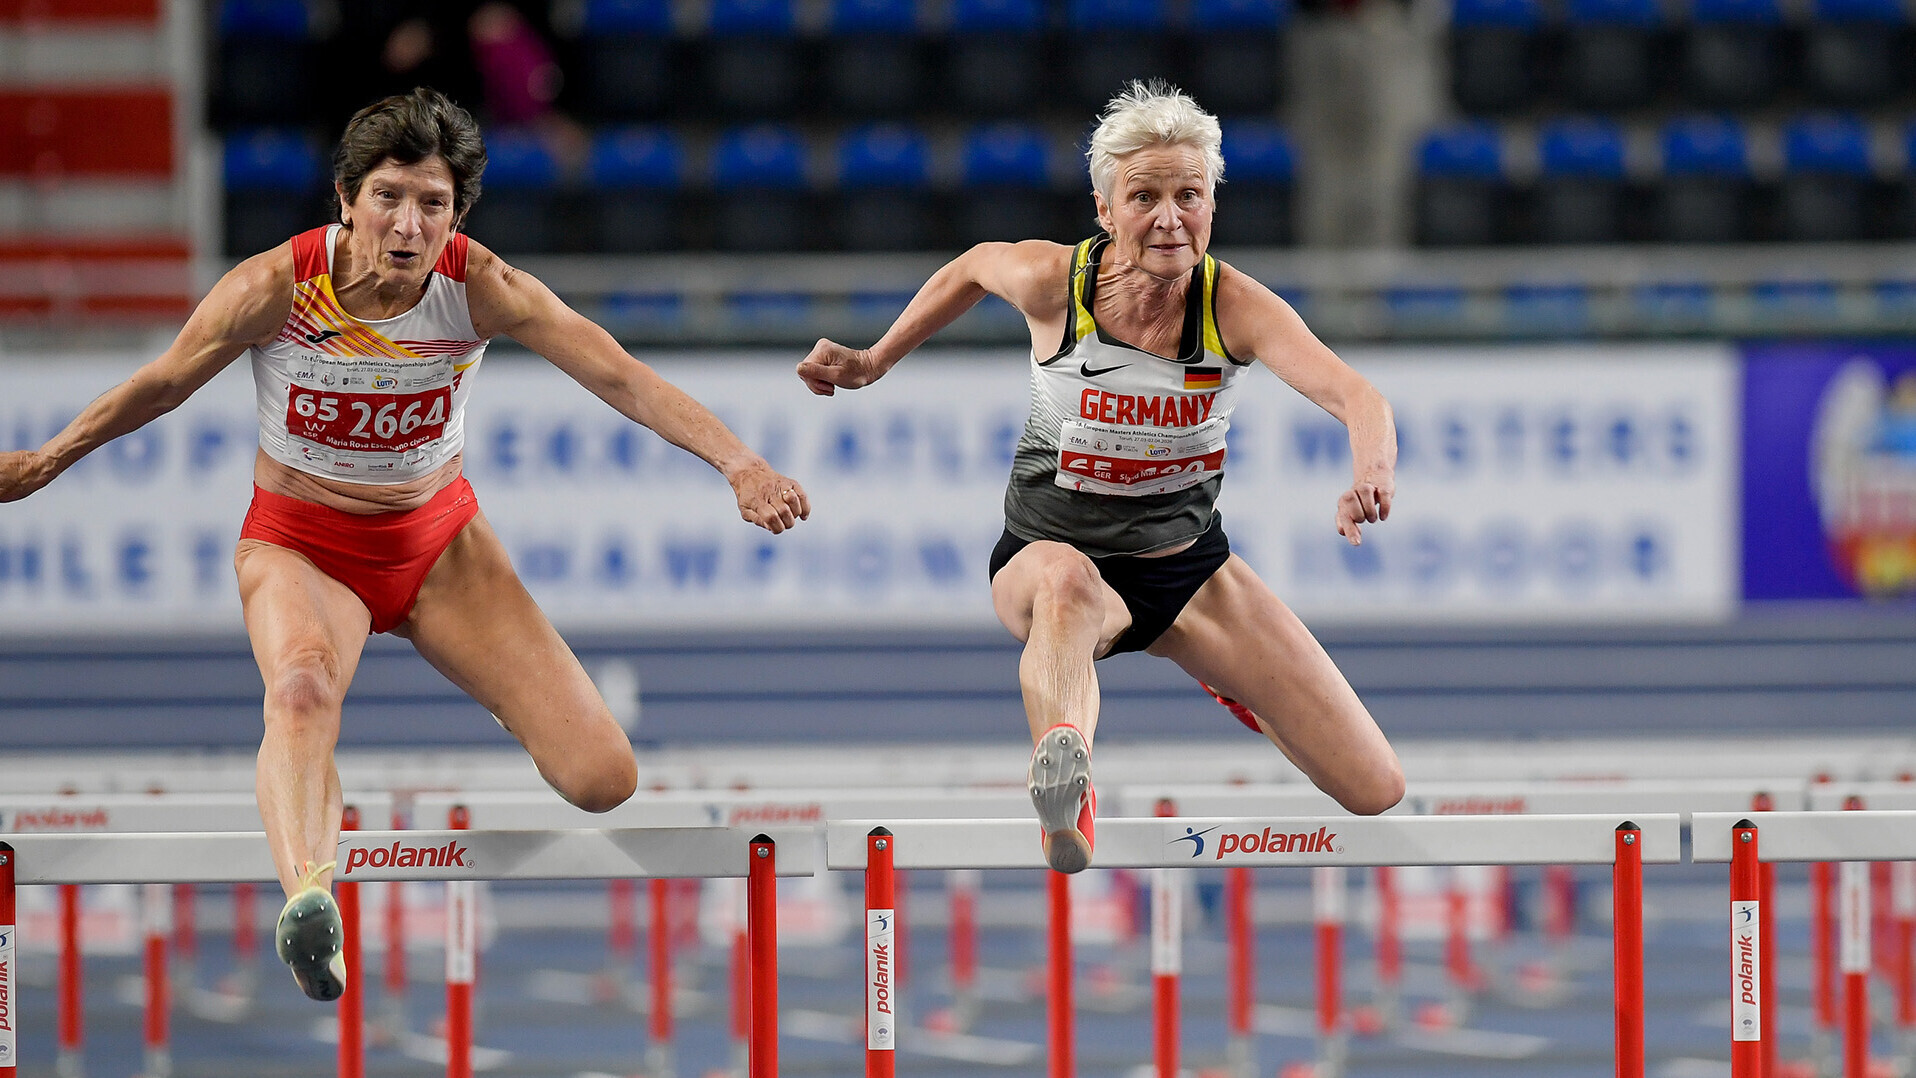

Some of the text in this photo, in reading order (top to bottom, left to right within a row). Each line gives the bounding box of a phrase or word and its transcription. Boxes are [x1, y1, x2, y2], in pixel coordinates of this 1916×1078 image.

[384, 361, 426, 369] Championships
[295, 394, 445, 440] 65 2664
[1080, 388, 1216, 428] GERMANY
[304, 420, 327, 432] W
[325, 436, 348, 447] Maria
[1083, 423, 1109, 433] European
[1158, 430, 1199, 439] Championships
[1094, 471, 1111, 480] GER
[344, 840, 468, 875] polanik
[1216, 826, 1337, 861] polanik
[872, 942, 891, 1015] polanik
[1737, 934, 1756, 1006] polanik
